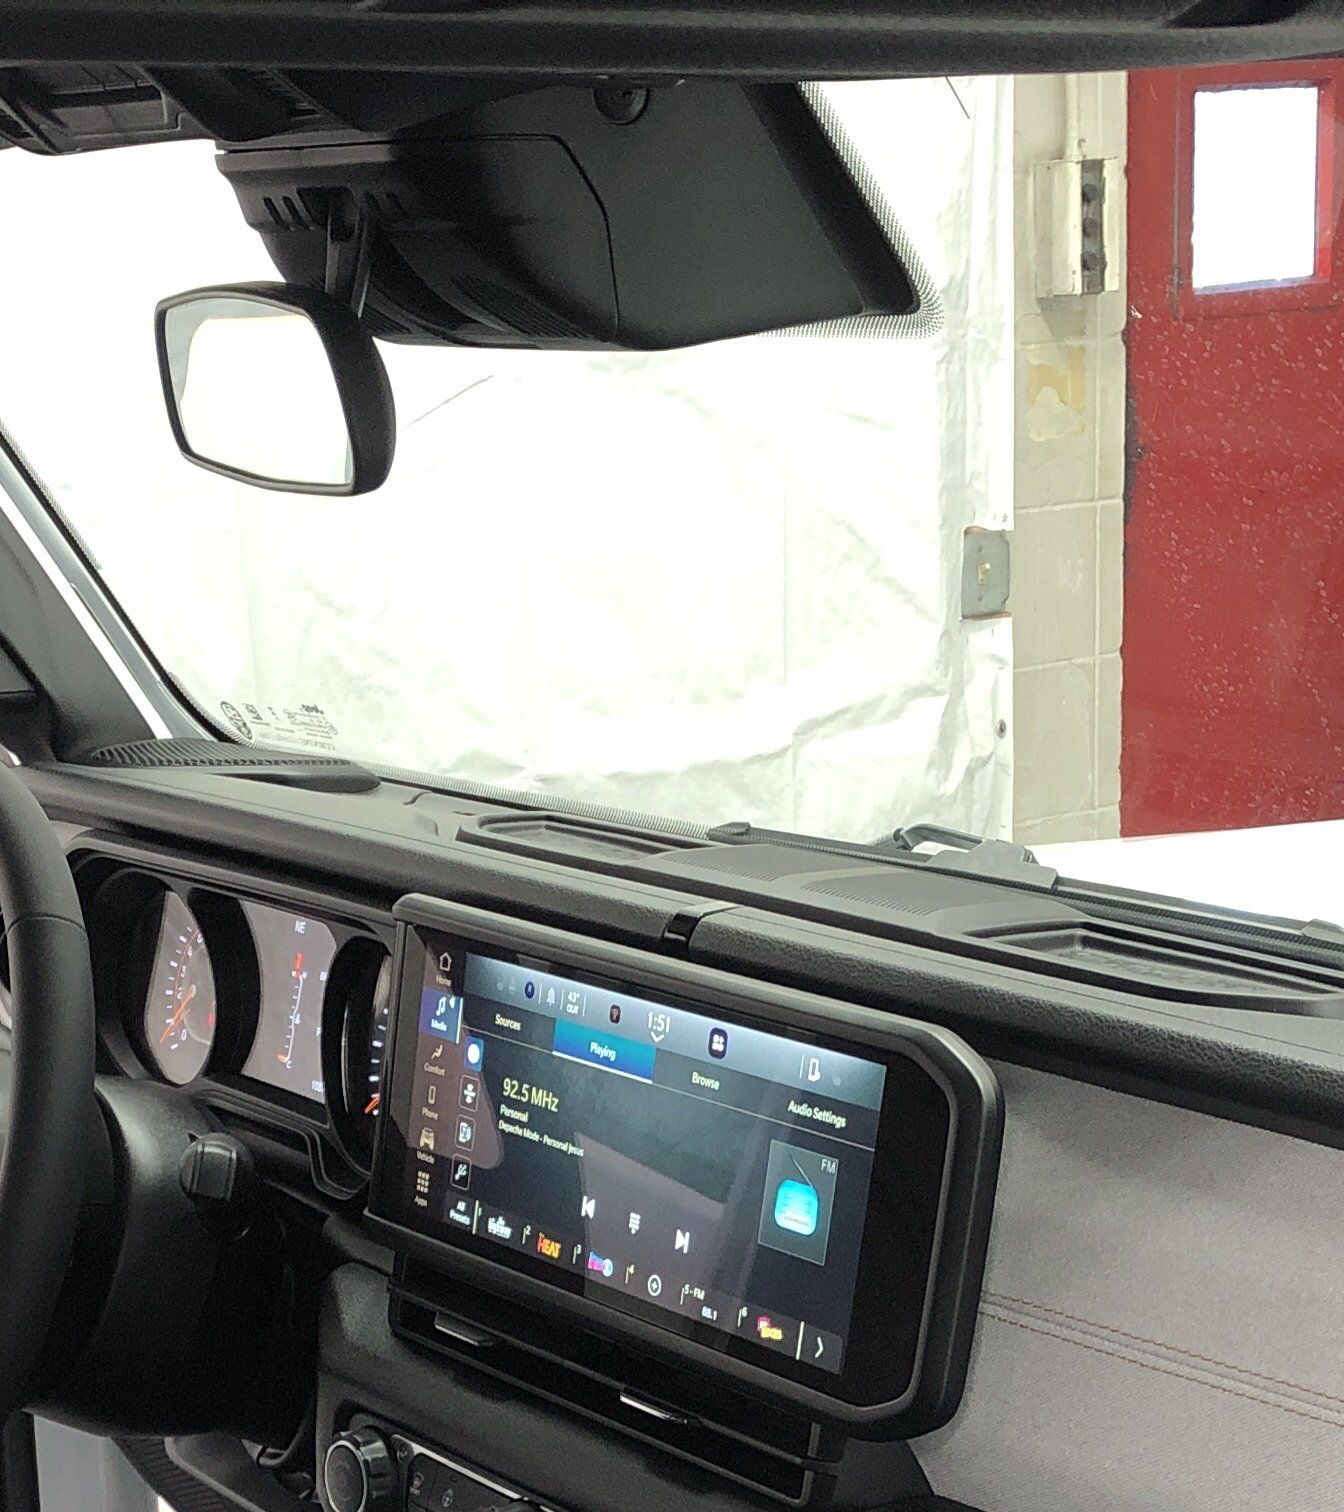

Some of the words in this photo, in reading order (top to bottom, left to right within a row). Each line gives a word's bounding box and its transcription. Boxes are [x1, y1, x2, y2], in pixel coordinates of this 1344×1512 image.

[435, 974, 452, 987] Home
[430, 1018, 448, 1032] Media
[495, 1013, 521, 1031] Sources
[647, 1011, 671, 1034] 1:51
[589, 1041, 616, 1061] Playing
[424, 1062, 446, 1077] Comfort
[691, 1071, 720, 1091] Browse
[503, 1078, 530, 1103] 92.5
[530, 1086, 559, 1112] MHz
[421, 1107, 439, 1120] Phone
[499, 1103, 529, 1123] Personal
[787, 1099, 812, 1118] Audio
[813, 1106, 847, 1129] Settings
[523, 1127, 540, 1142] Mode
[542, 1134, 568, 1152] Personal
[416, 1151, 435, 1165] Vehicle
[820, 1158, 836, 1174] FM
[525, 1224, 532, 1236] 2
[537, 1236, 562, 1259] HEAT
[741, 1306, 748, 1318] 6
